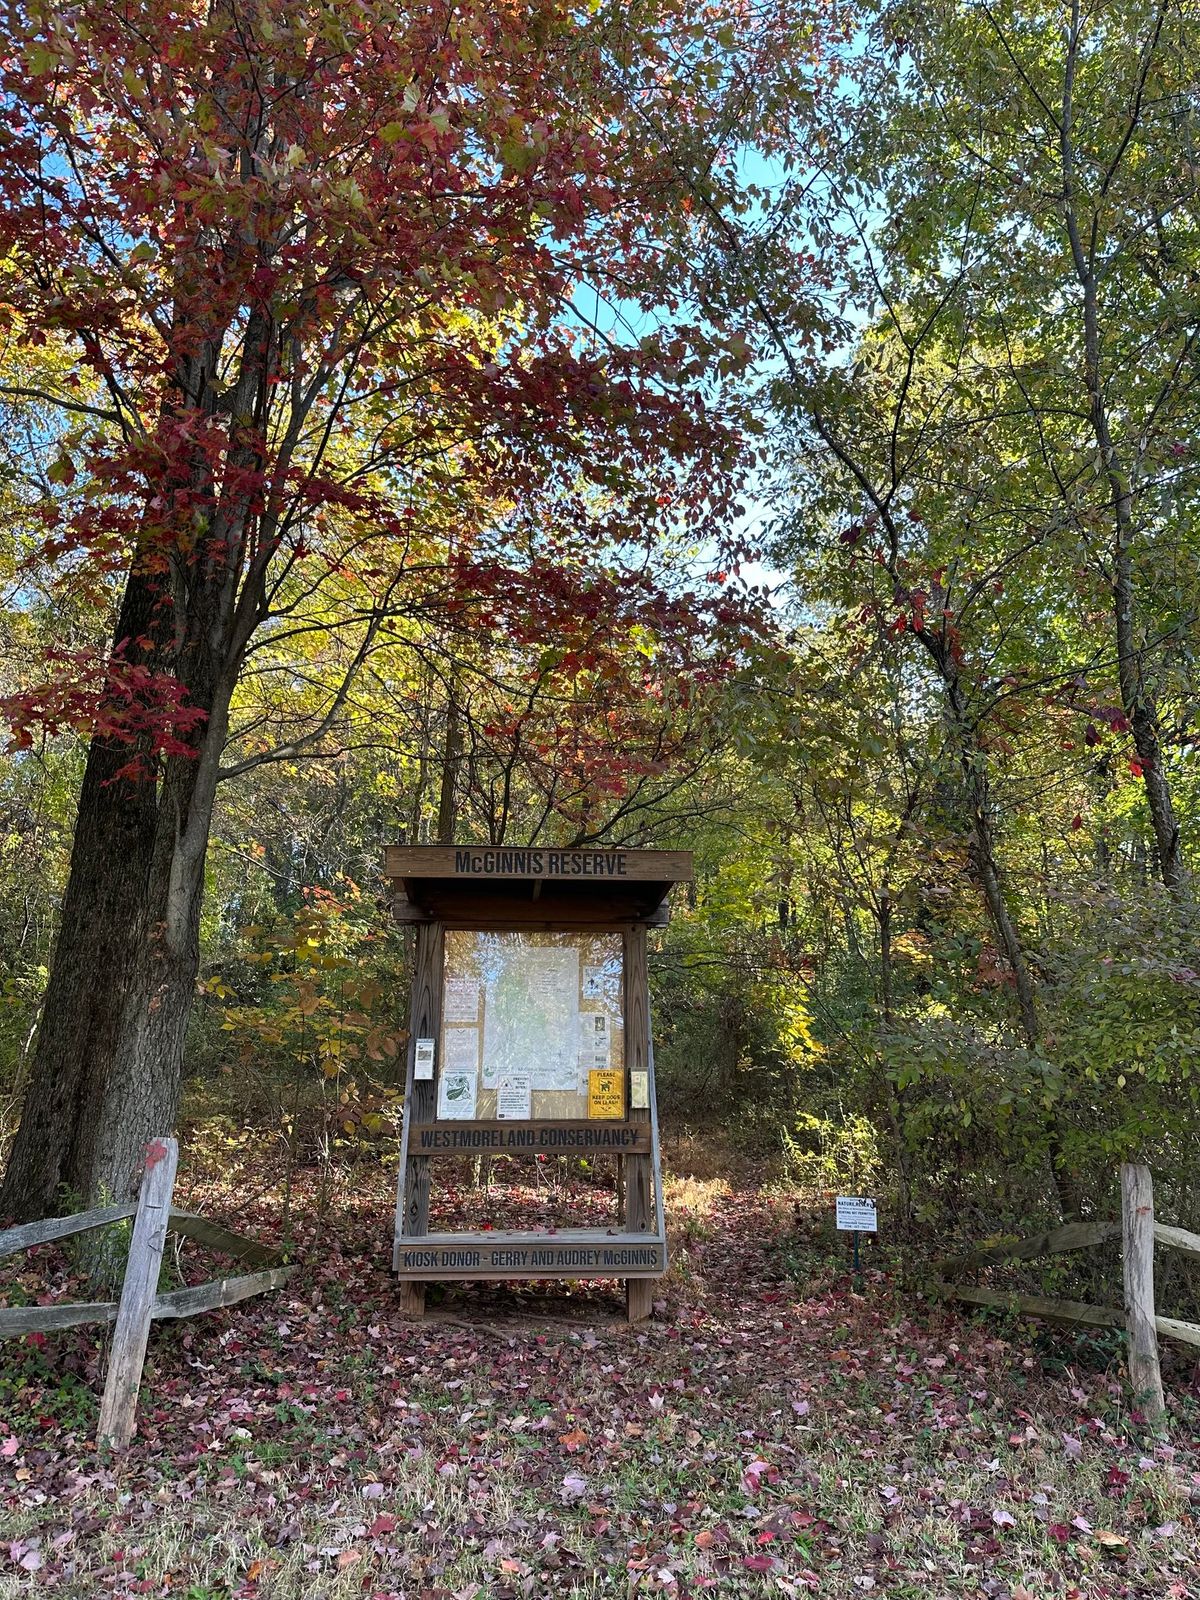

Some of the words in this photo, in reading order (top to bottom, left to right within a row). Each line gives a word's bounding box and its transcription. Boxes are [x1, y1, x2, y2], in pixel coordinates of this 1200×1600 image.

[455, 851, 544, 874] McGINNIS
[548, 852, 627, 875] RESERVE
[420, 1129, 536, 1148] WESTMORELAND
[540, 1128, 638, 1146] CONSERVANCY
[403, 1251, 438, 1267] KIOSK
[441, 1251, 480, 1267] DONOR
[491, 1250, 528, 1266] GERRY
[531, 1250, 554, 1266] AND
[556, 1250, 601, 1265] AUDREY
[603, 1249, 658, 1265] McGINNIS
